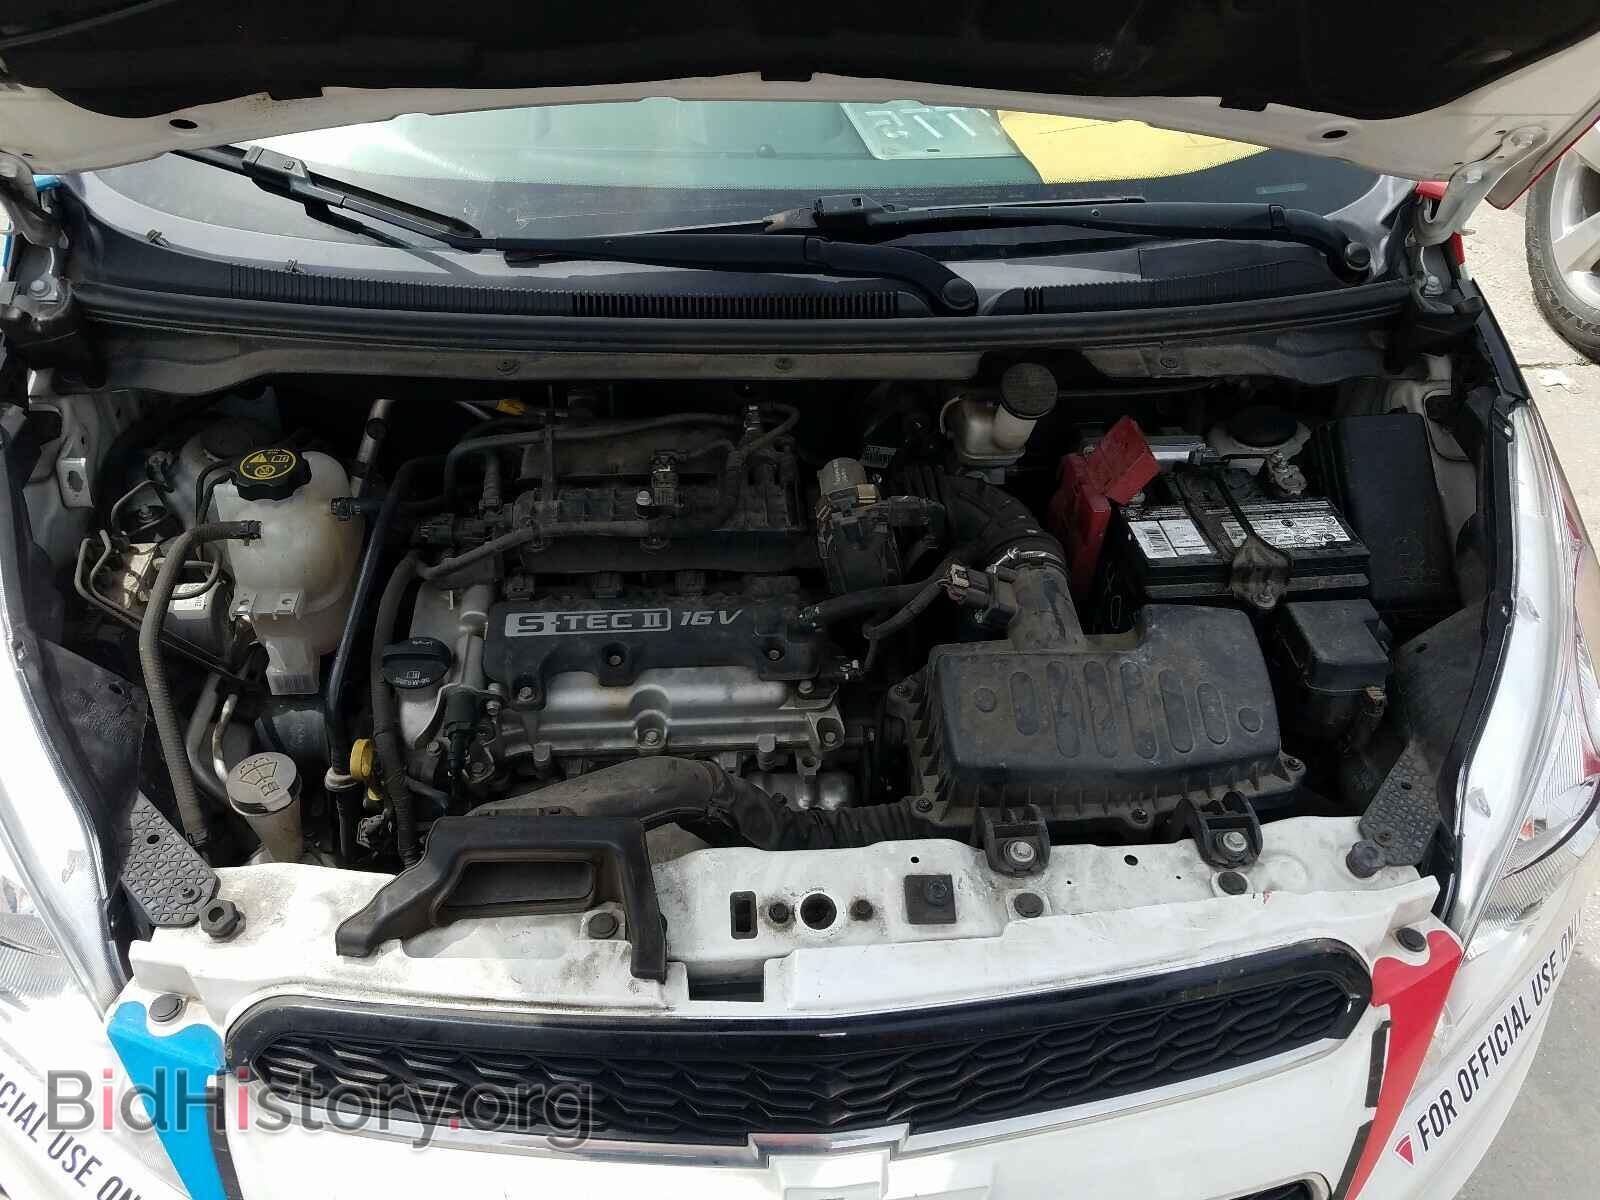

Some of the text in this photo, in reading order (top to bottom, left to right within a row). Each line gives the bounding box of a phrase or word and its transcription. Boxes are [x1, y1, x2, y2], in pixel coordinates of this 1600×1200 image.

[680, 608, 744, 626] 16V
[1417, 1089, 1458, 1152] FOR
[1457, 996, 1532, 1103] OFFICIAL
[1531, 949, 1558, 1006] USE
[0, 1072, 47, 1143] CIAL
[47, 1130, 103, 1188] USE
